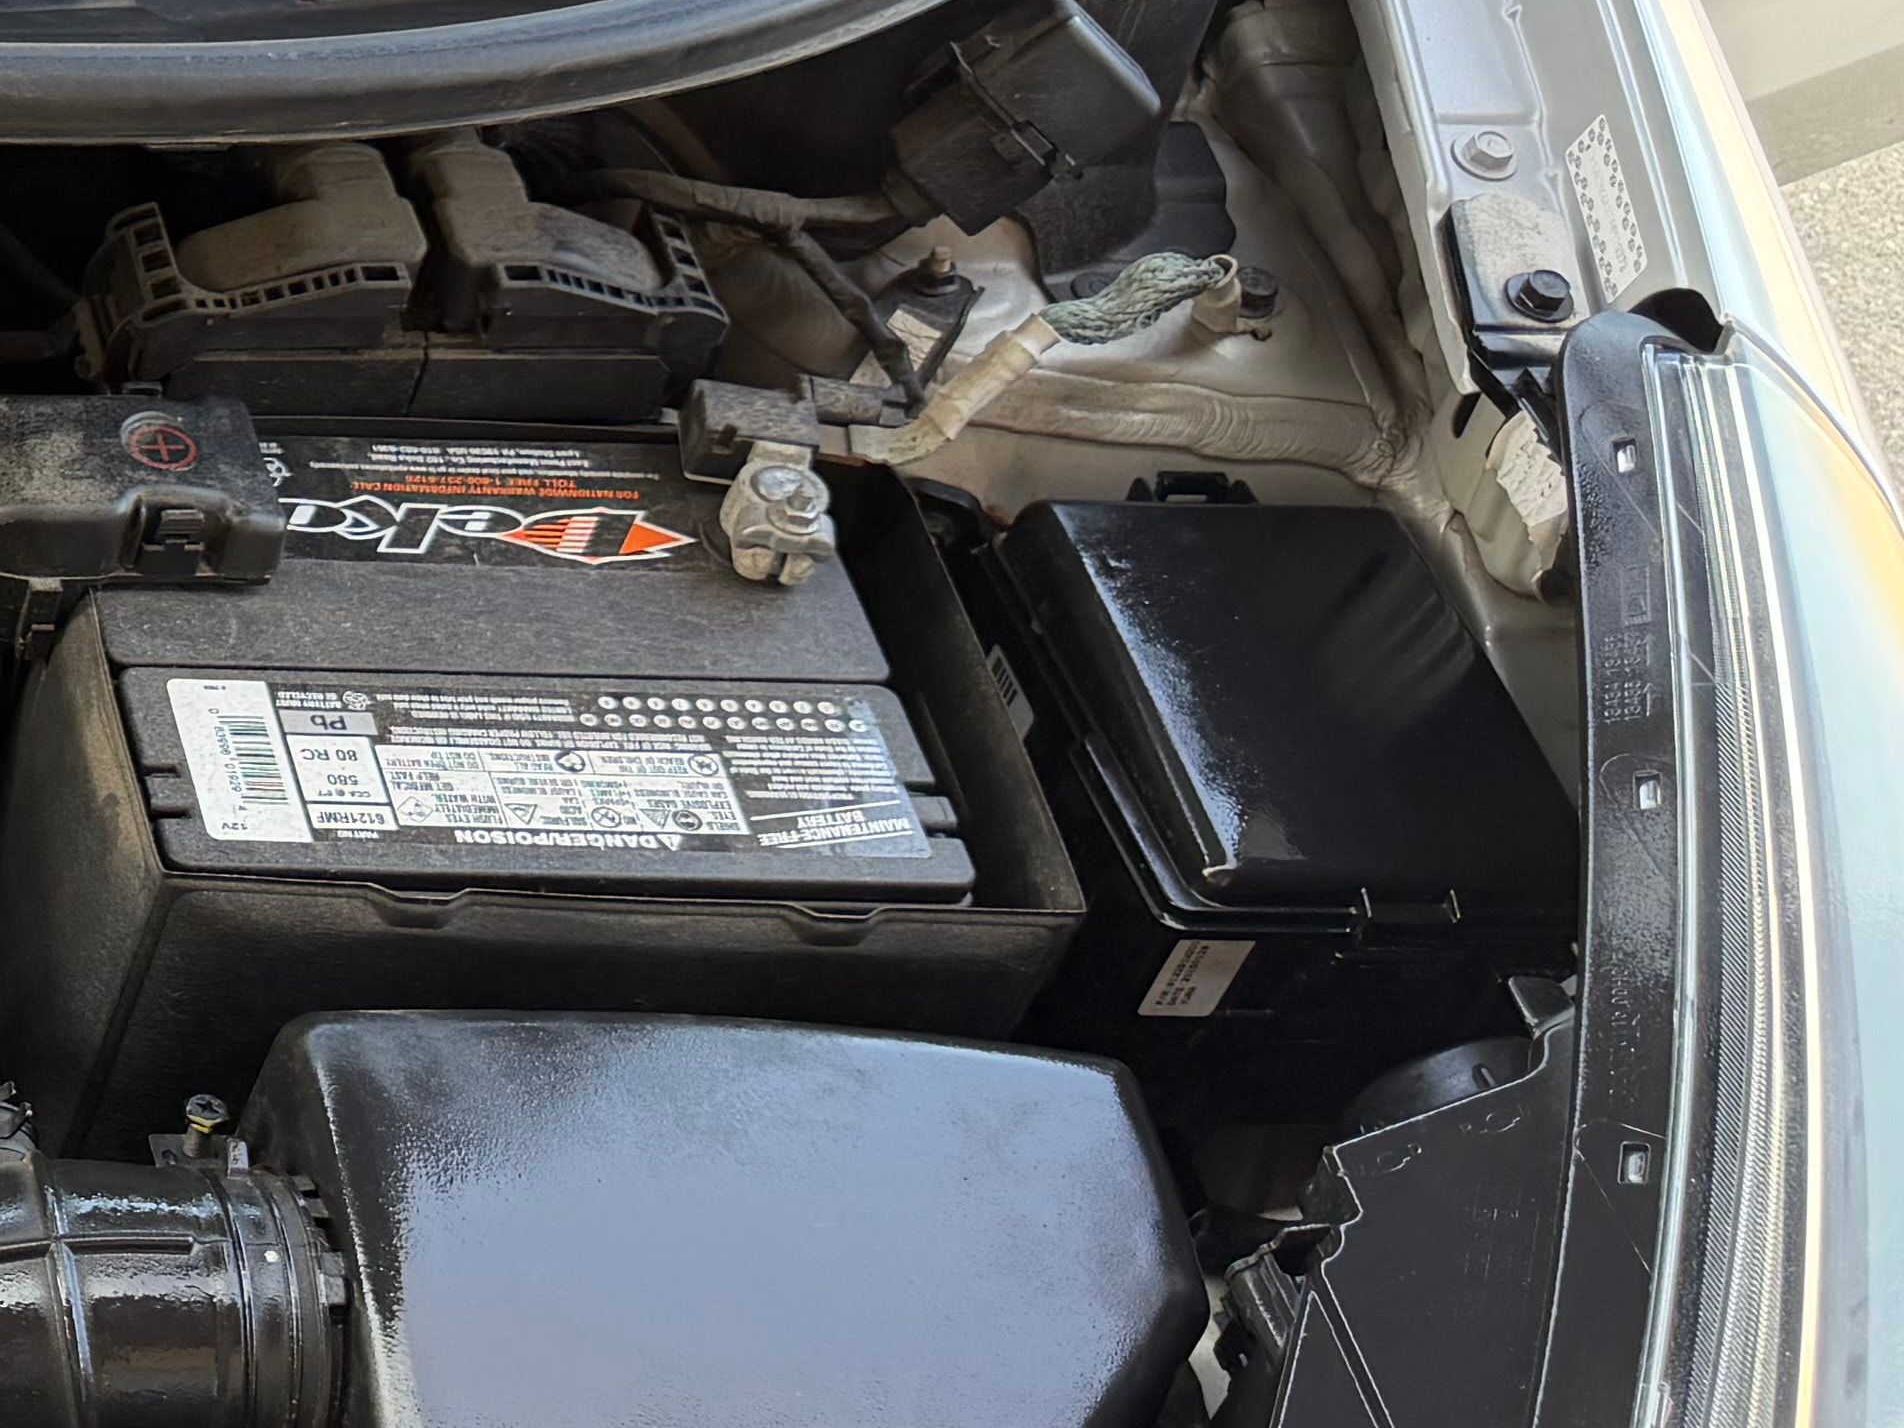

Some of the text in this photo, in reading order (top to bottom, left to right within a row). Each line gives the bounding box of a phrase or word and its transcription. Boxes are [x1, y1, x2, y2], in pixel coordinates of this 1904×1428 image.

[382, 483, 465, 494] INFORMATION
[543, 478, 575, 488] TOLL
[466, 485, 536, 496] WARRANTY
[539, 488, 614, 499] NATIONWIDE
[309, 715, 347, 730] Pb
[299, 748, 358, 762] 80 RC
[326, 774, 358, 786] 580
[316, 811, 385, 825] 6121RMF
[795, 808, 863, 829] BATTERY
[221, 822, 248, 831] 12V
[757, 816, 910, 847] MAINTENANCE-FREE
[454, 829, 657, 851] DANGER/POISON
